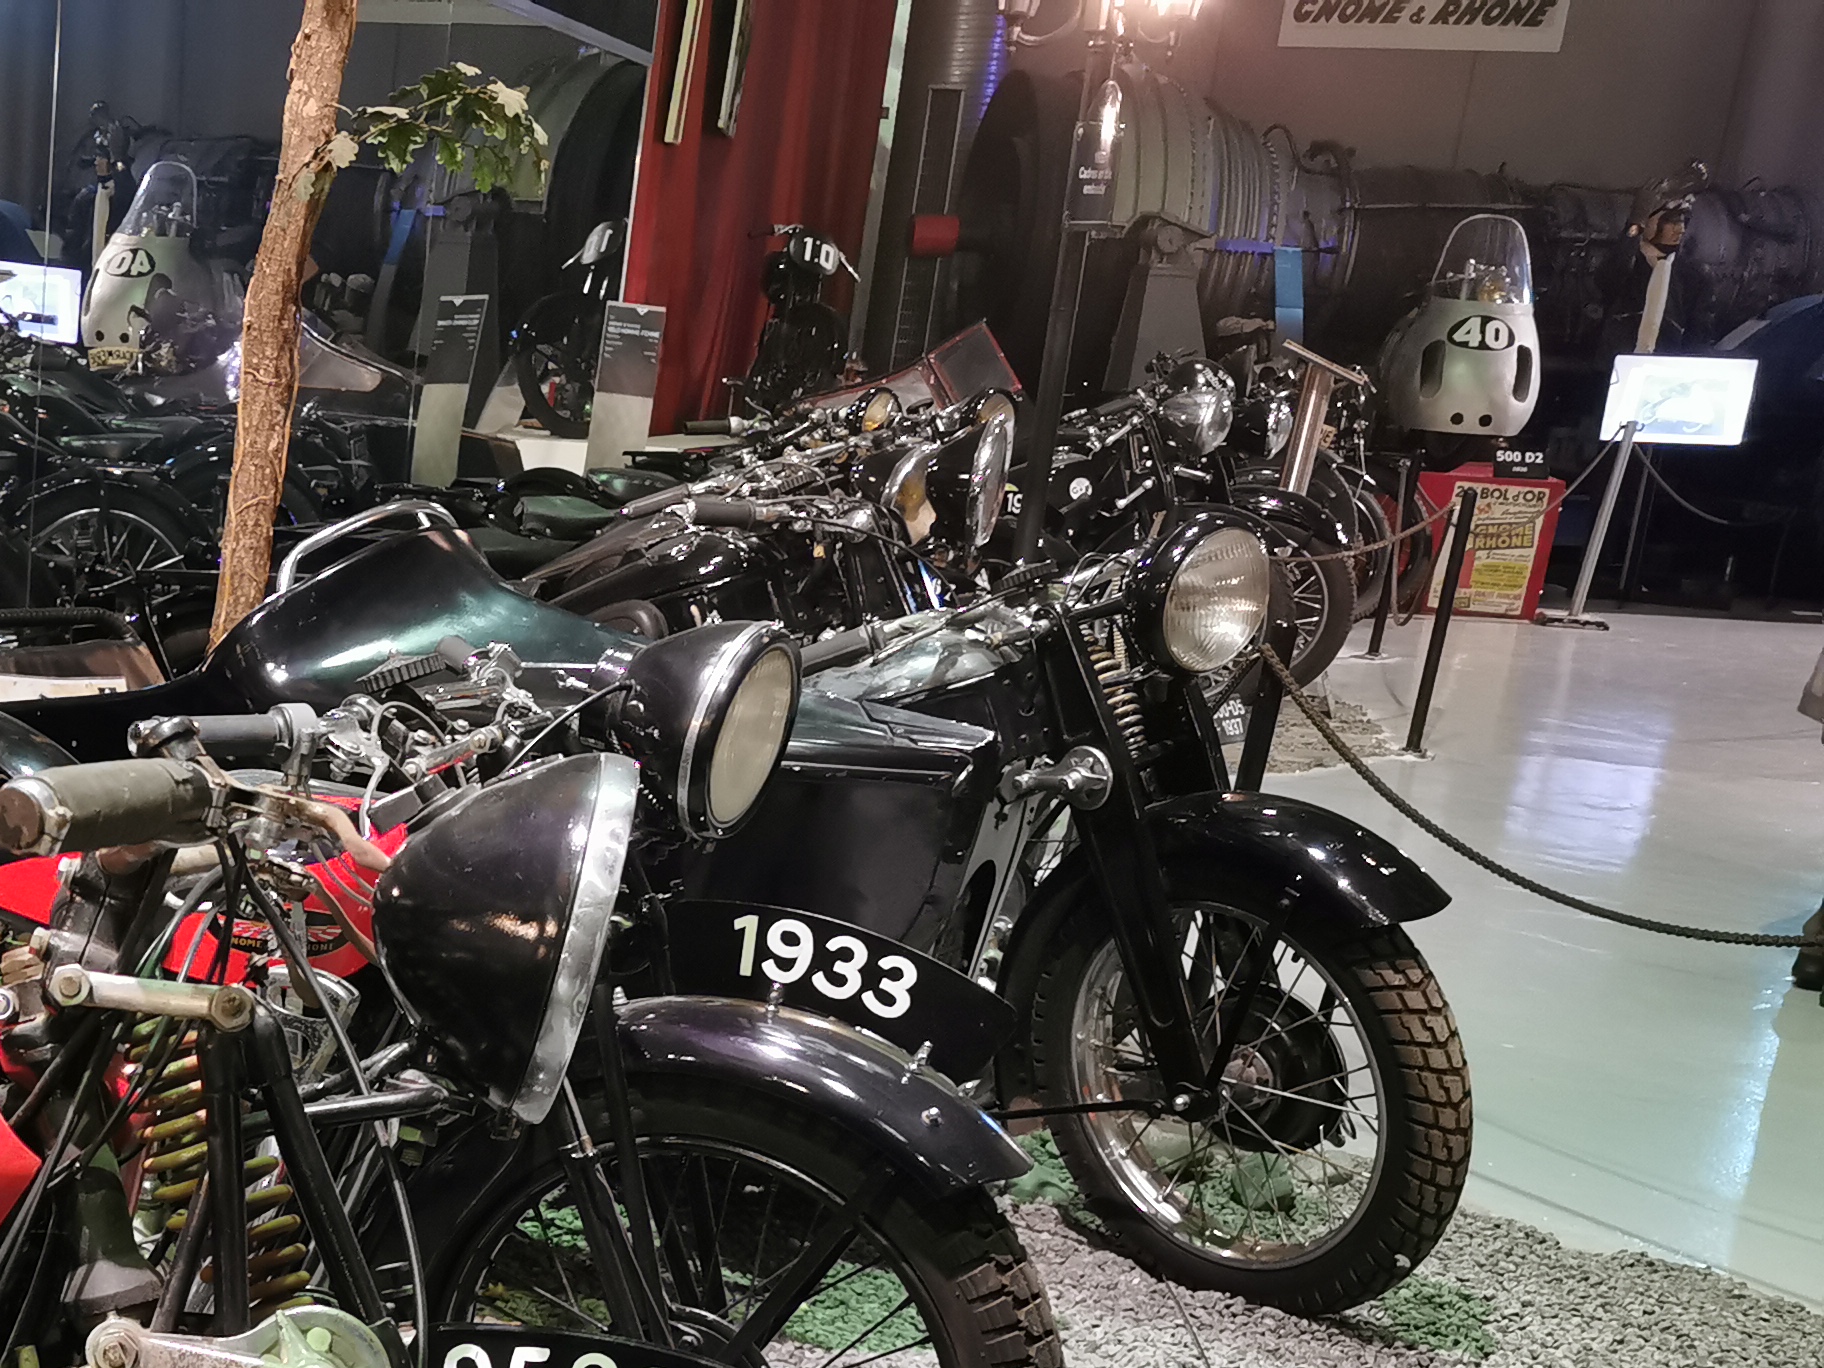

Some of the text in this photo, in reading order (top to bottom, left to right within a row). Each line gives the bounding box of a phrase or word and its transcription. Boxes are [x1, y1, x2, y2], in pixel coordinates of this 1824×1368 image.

[1293, 0, 1556, 27] GNOME & RHONE
[1452, 317, 1508, 349] 40
[1496, 450, 1544, 464] 500 D2
[1480, 487, 1509, 500] BOL
[733, 914, 918, 1019] 1933
